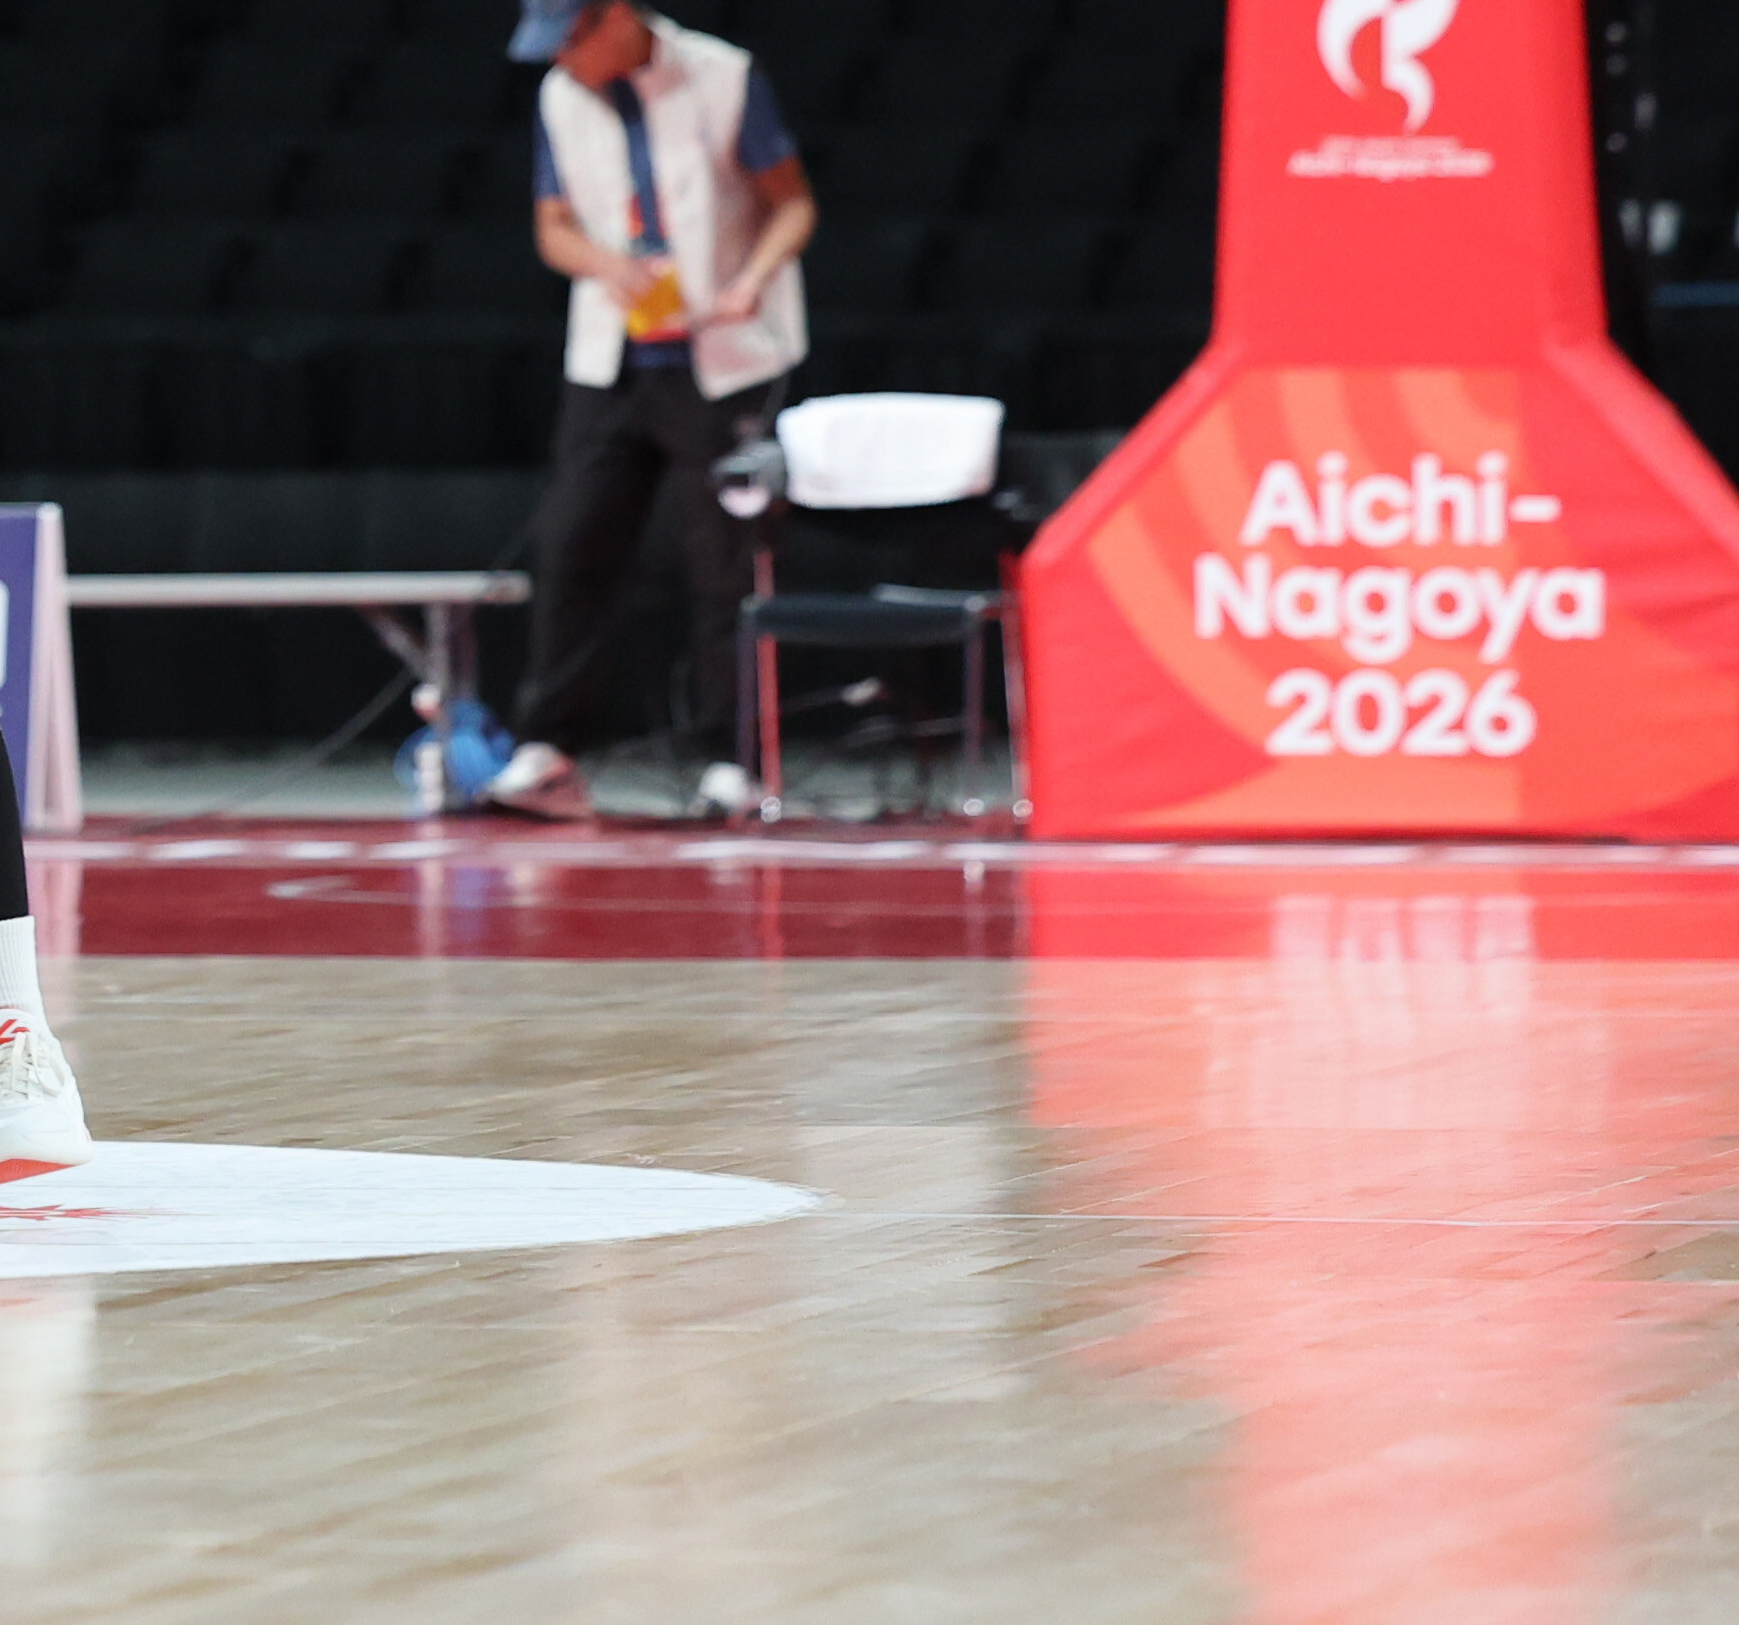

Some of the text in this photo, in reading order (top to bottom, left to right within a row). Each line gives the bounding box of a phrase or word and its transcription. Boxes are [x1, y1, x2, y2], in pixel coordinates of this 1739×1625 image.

[1237, 450, 1561, 548] Aichi-
[1192, 552, 1607, 666] Nagoya
[1263, 666, 1537, 759] 2026
